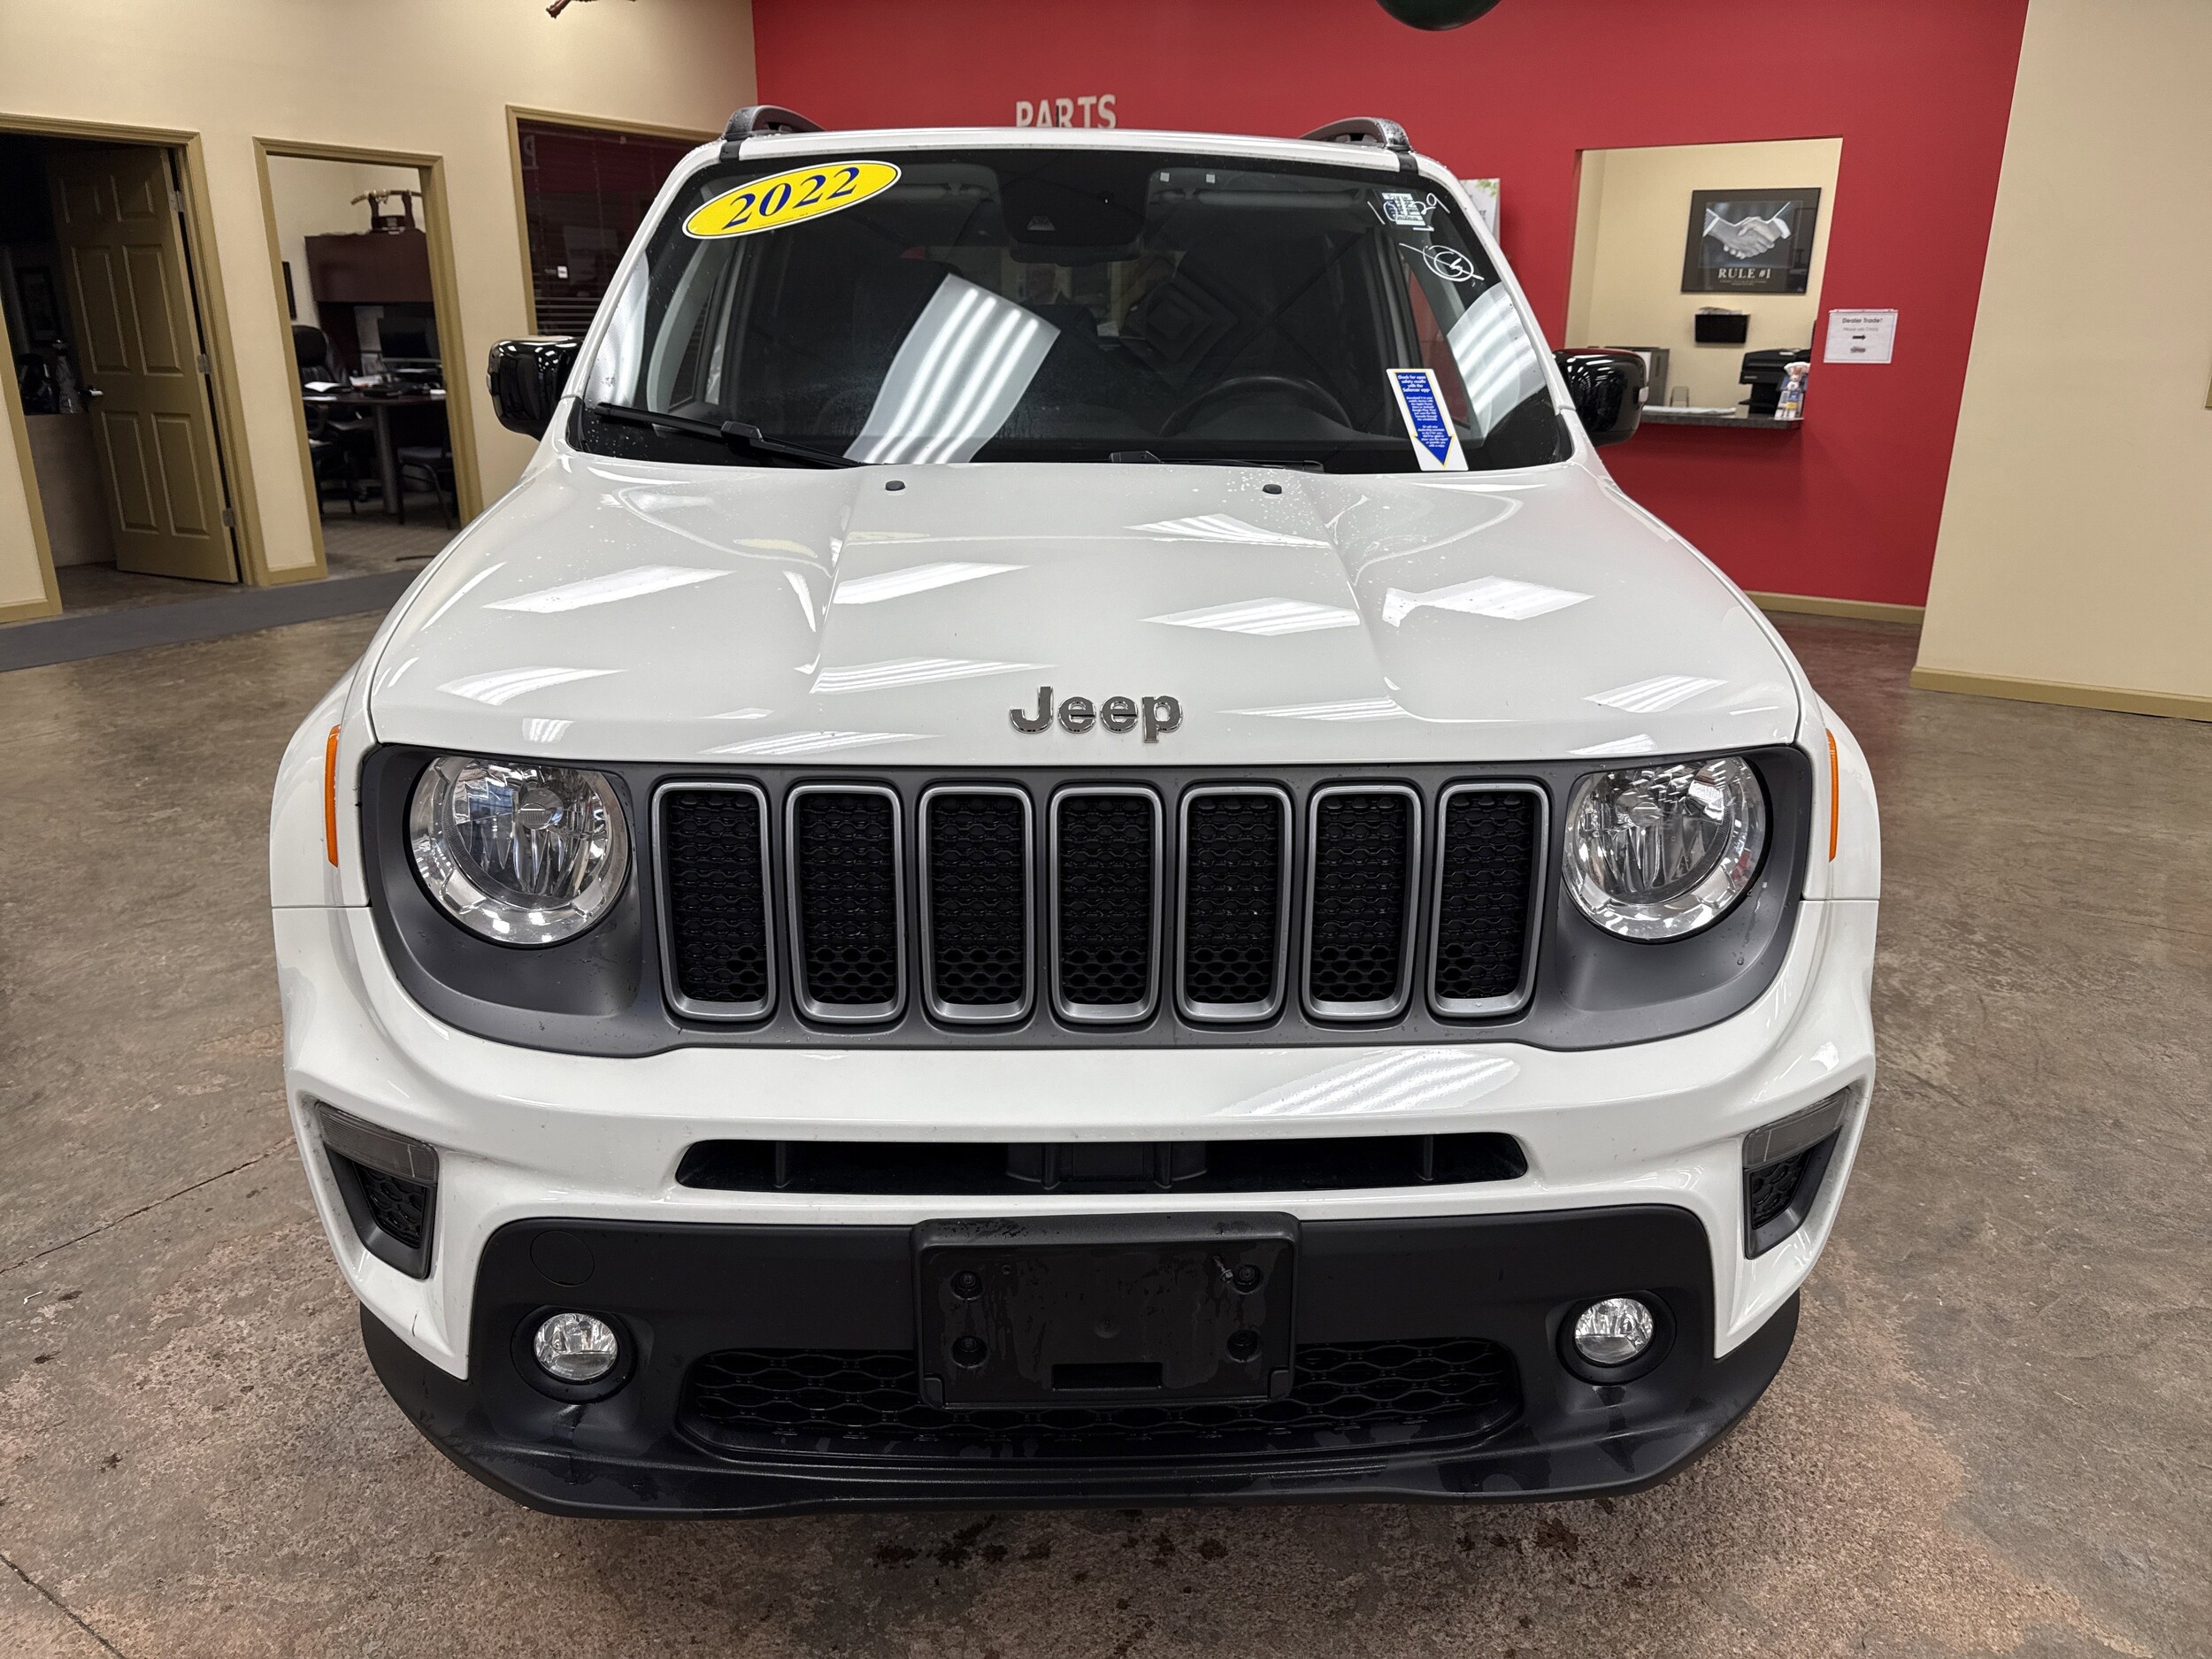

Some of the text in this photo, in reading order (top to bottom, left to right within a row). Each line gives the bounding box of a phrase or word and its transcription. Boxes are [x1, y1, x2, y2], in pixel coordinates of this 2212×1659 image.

[1016, 94, 1117, 129] PARTS
[721, 166, 860, 230] 2022
[1717, 268, 1771, 279] RULE #1
[1010, 686, 1183, 743] Jeep
